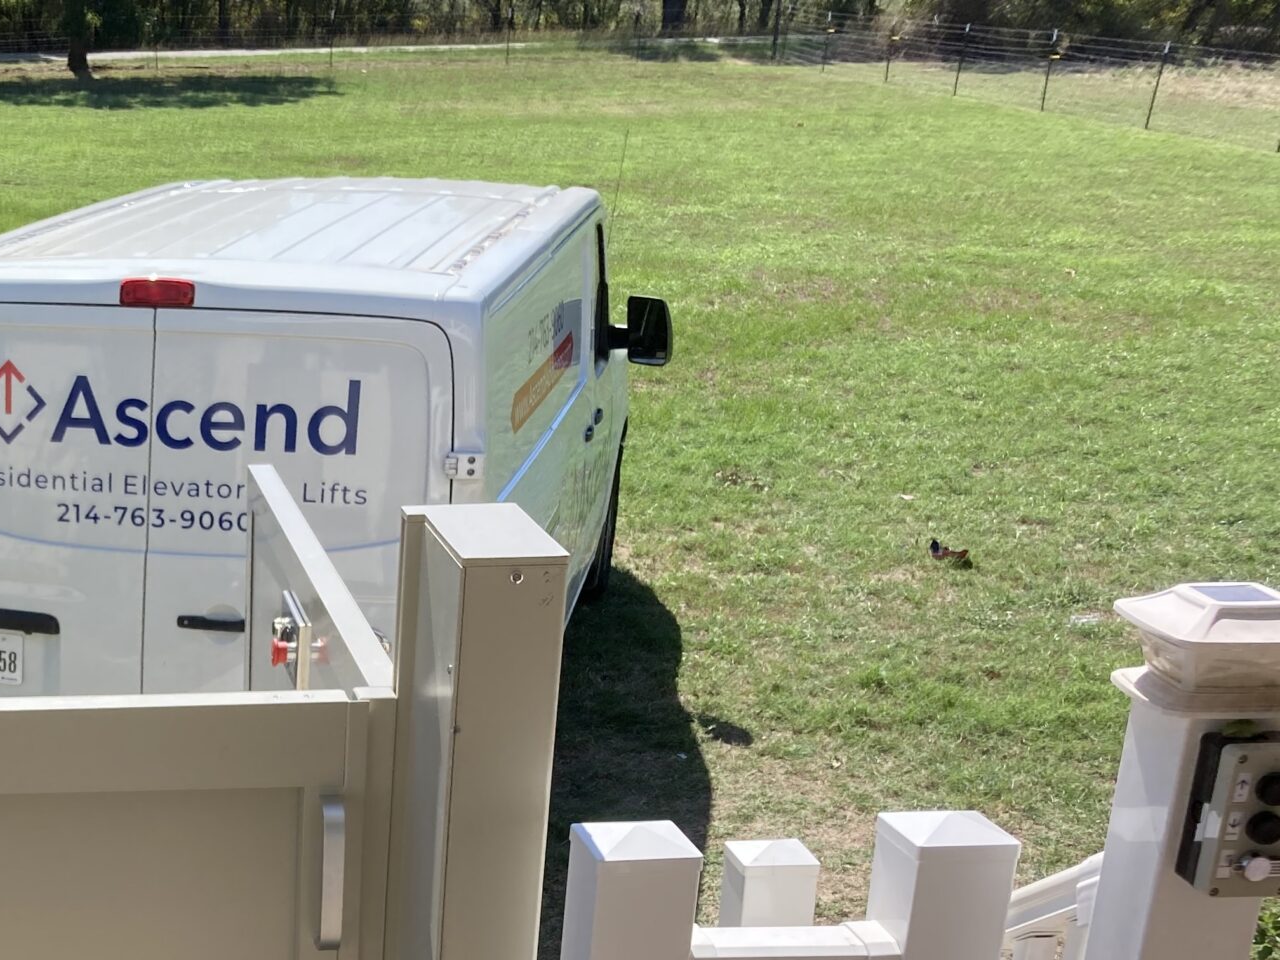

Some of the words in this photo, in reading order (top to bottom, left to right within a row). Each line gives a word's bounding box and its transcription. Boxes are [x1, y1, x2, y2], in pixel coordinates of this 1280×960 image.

[50, 375, 361, 456] Ascend
[124, 474, 246, 499] Elevator
[303, 482, 368, 505] Lifts
